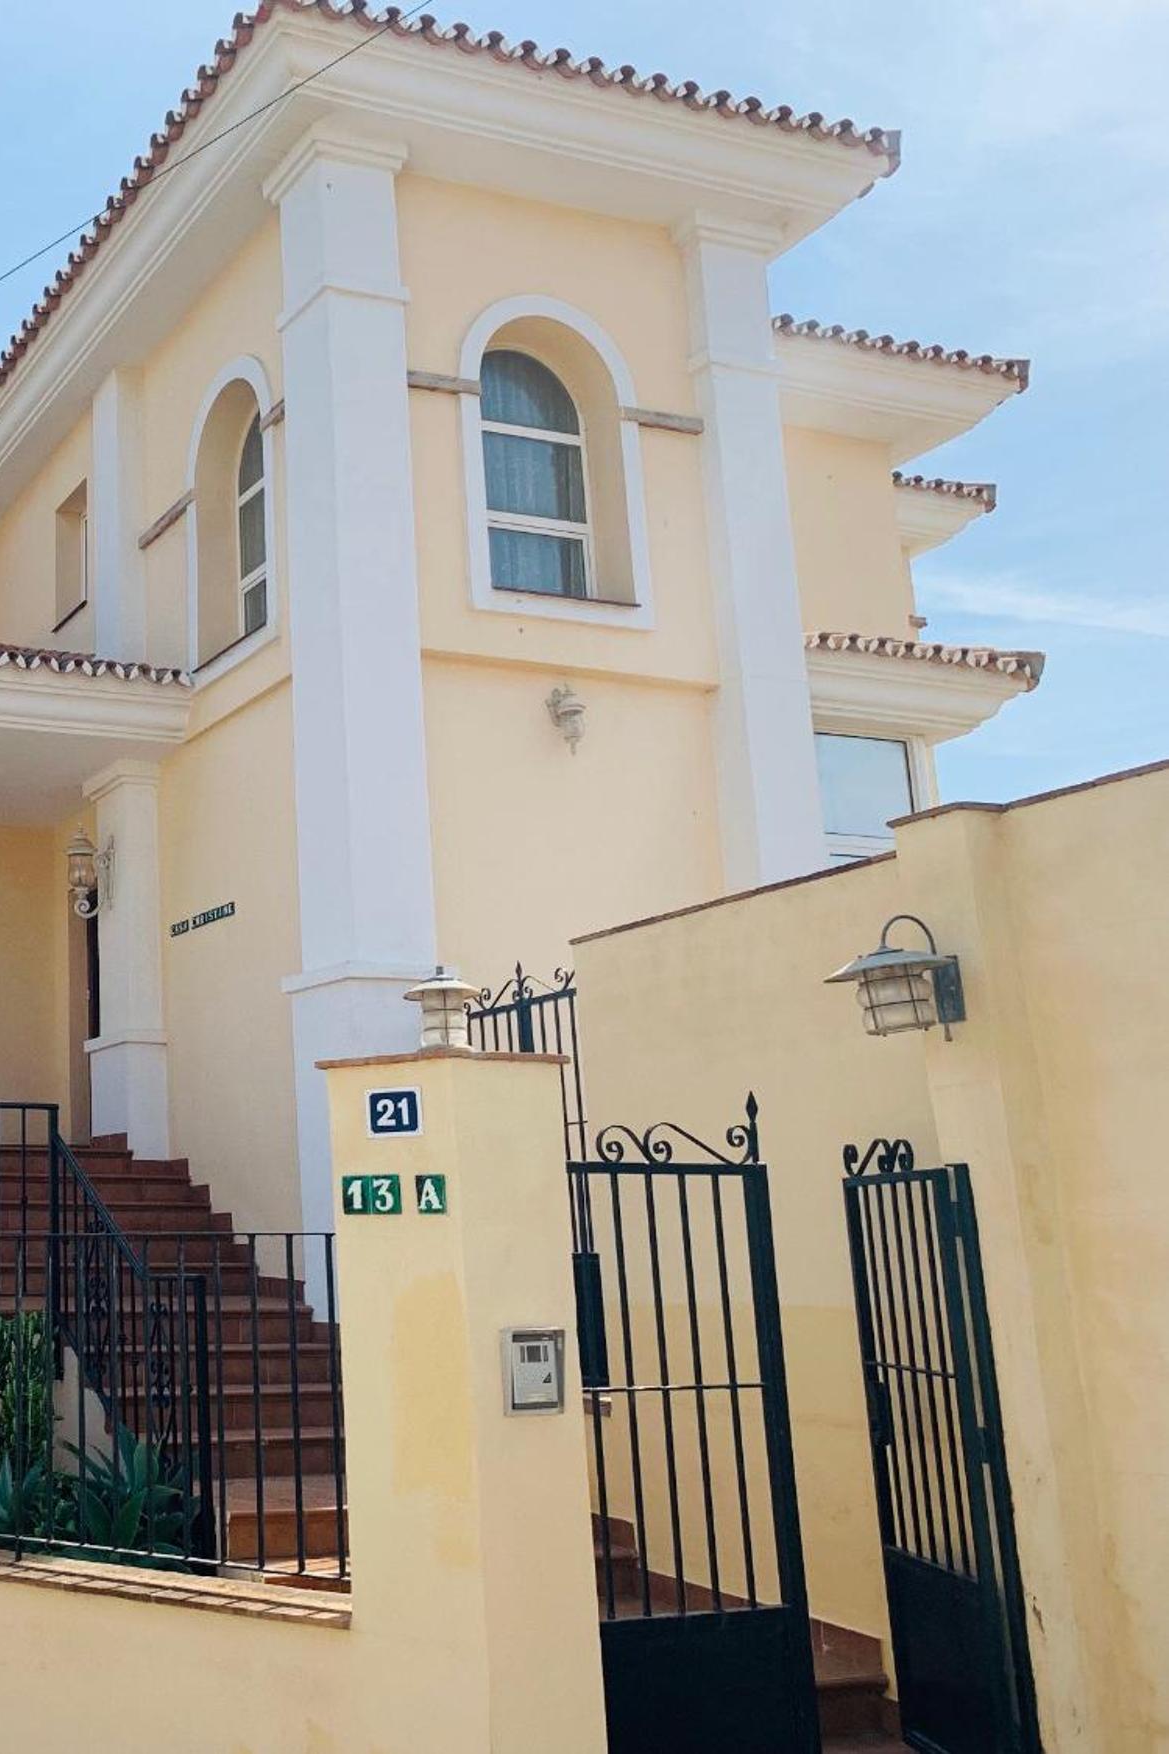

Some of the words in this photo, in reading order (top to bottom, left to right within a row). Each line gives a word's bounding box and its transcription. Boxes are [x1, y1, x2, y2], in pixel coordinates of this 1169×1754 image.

[376, 1097, 410, 1127] 21
[347, 1178, 394, 1211] 13
[418, 1178, 443, 1209] A
